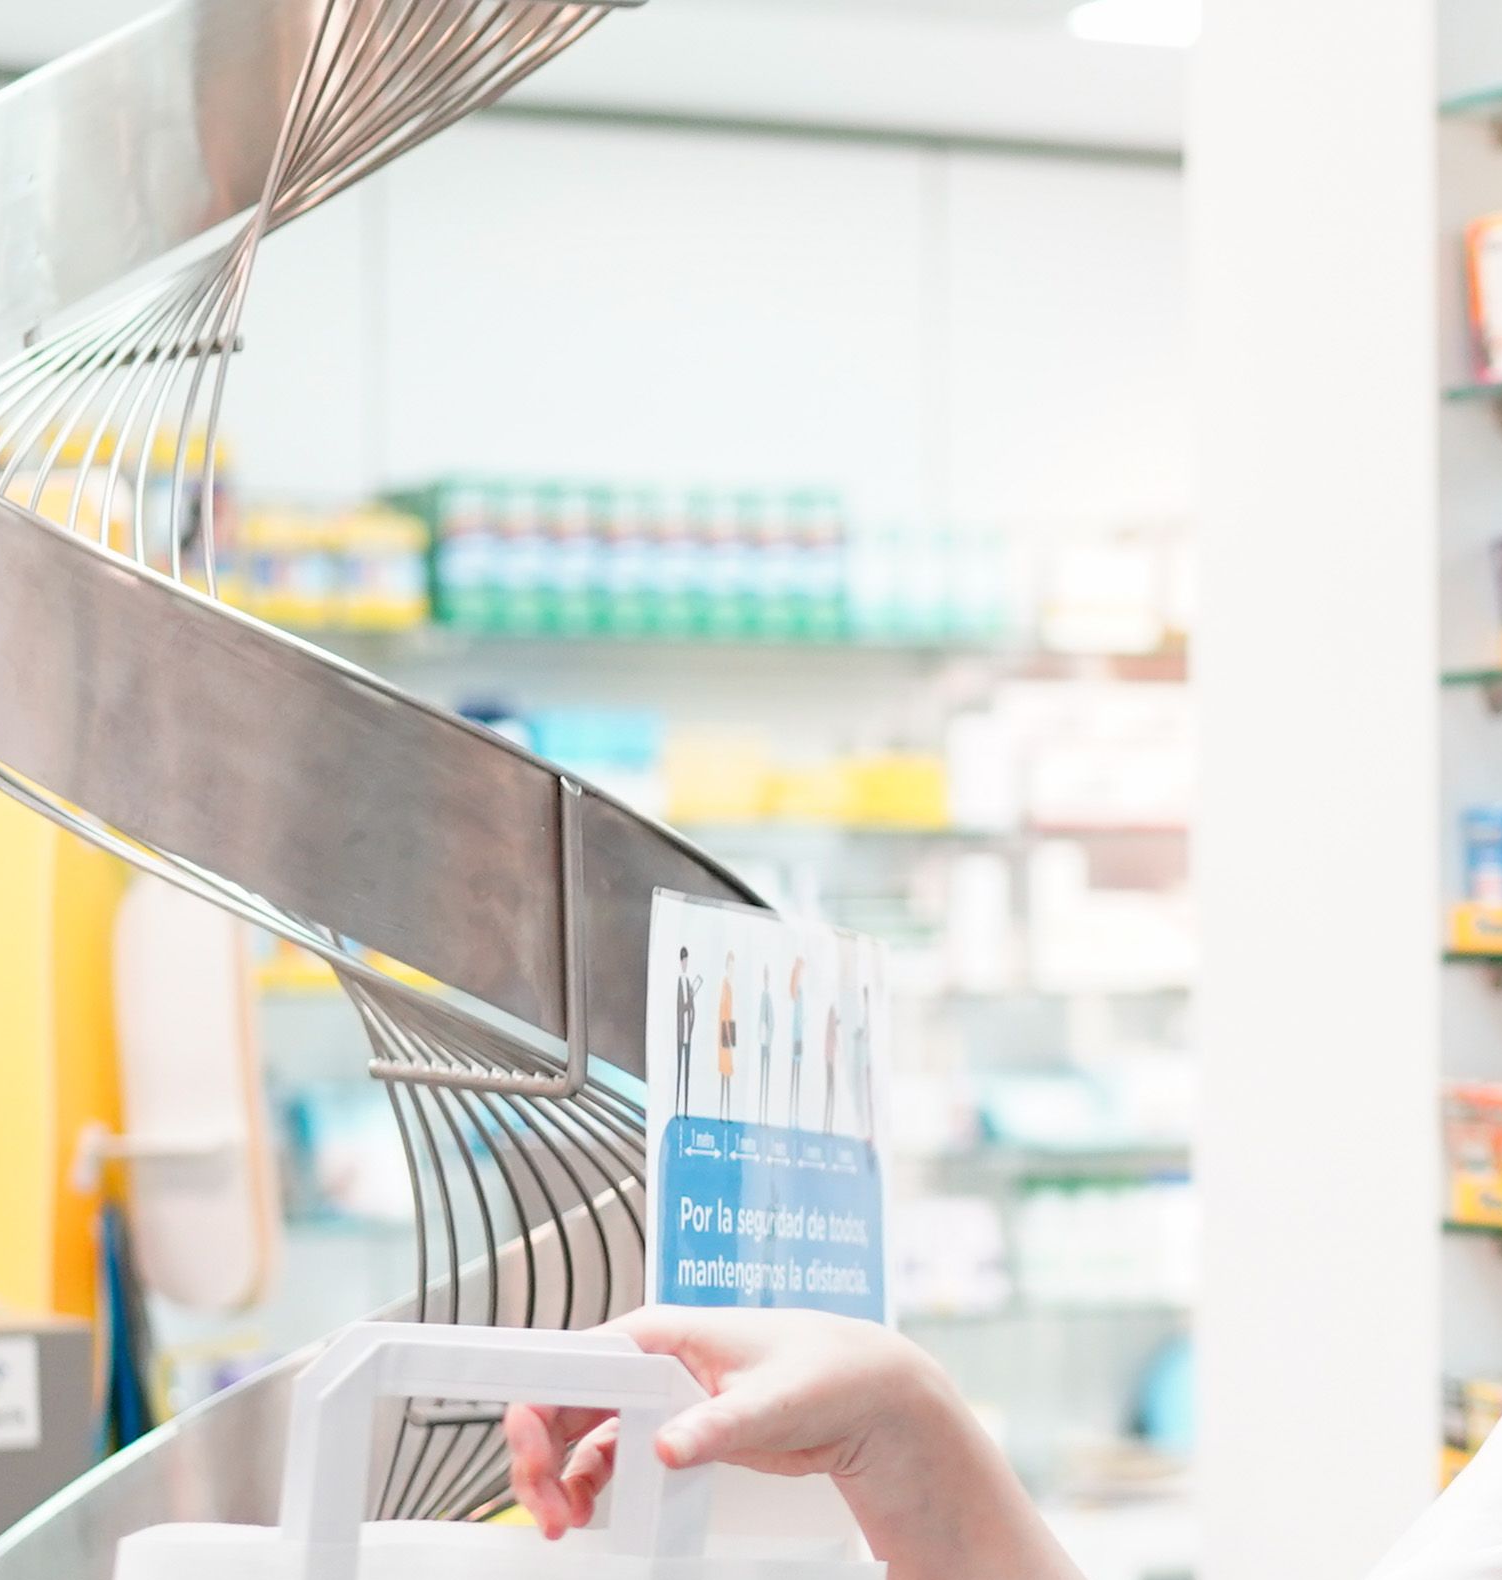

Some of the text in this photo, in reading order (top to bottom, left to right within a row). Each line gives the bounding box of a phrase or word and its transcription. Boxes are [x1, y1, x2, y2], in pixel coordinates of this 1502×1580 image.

[680, 1196, 713, 1232] Por
[717, 1197, 733, 1234] la
[807, 1206, 825, 1241] de
[678, 1254, 786, 1294] mantengamos
[788, 1257, 803, 1291] la
